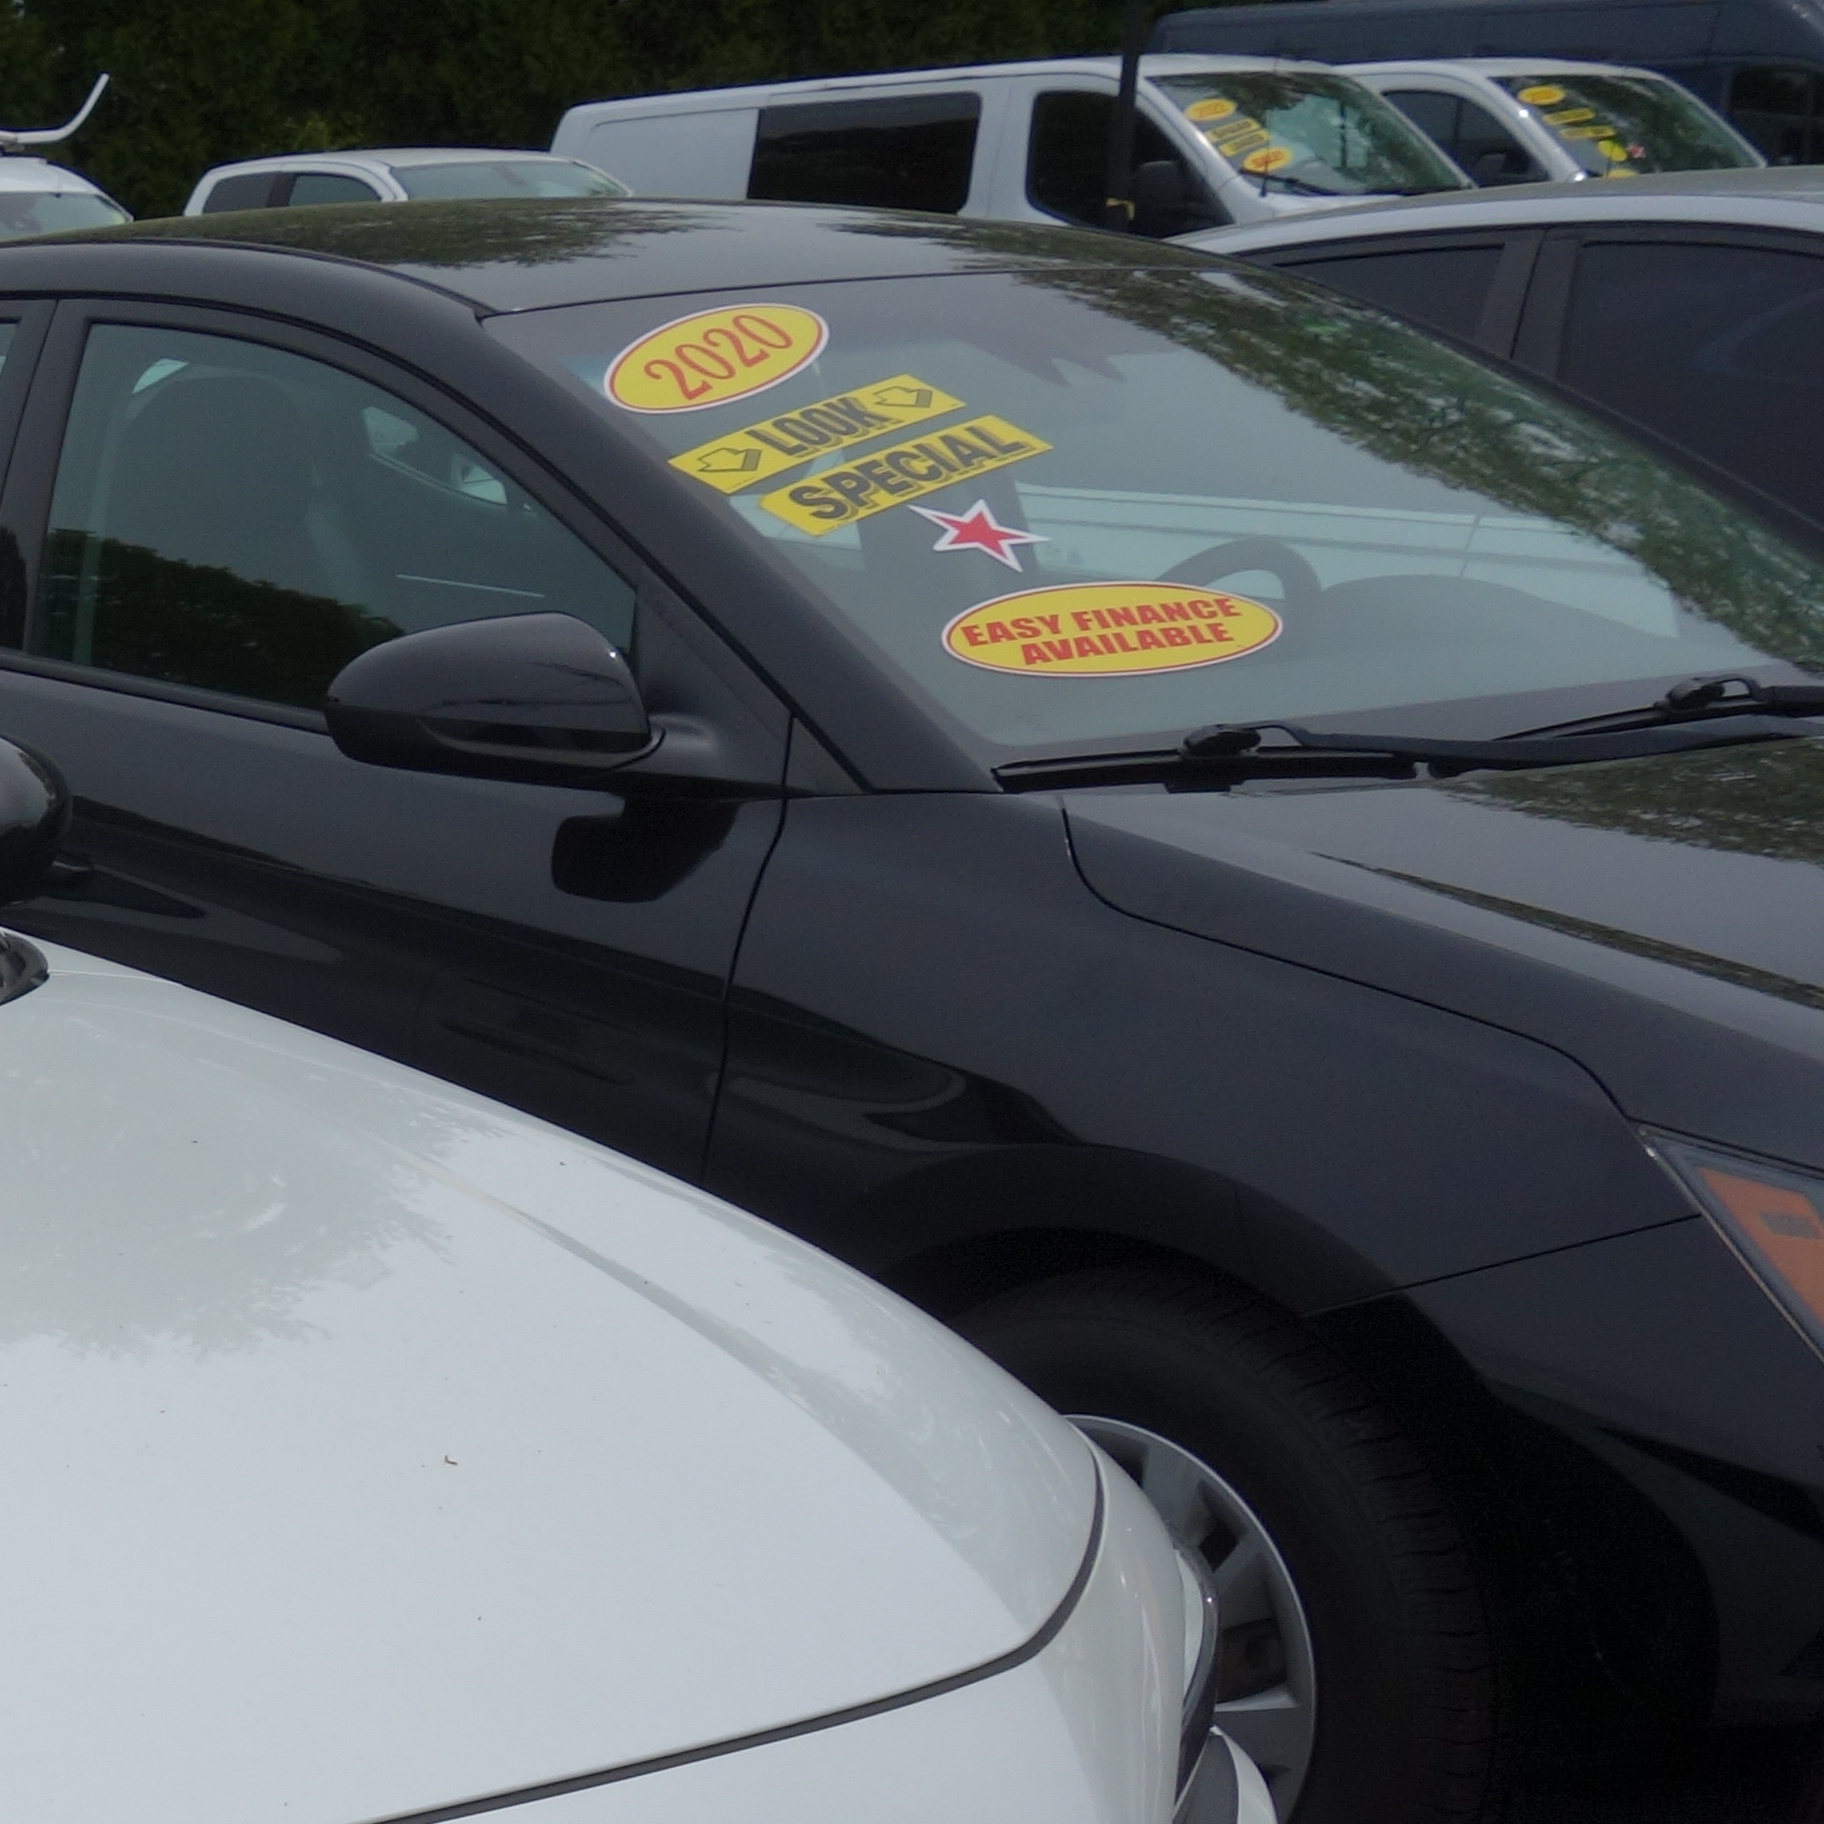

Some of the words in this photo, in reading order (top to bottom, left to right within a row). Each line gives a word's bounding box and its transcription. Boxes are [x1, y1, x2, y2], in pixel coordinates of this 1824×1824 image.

[643, 313, 794, 401] 2020
[746, 396, 905, 459] LOOK
[789, 424, 1032, 523] SPECIAL
[961, 613, 1063, 647] EASY
[1070, 596, 1243, 632] FINANCE
[1020, 622, 1235, 667] AVAILABLE
